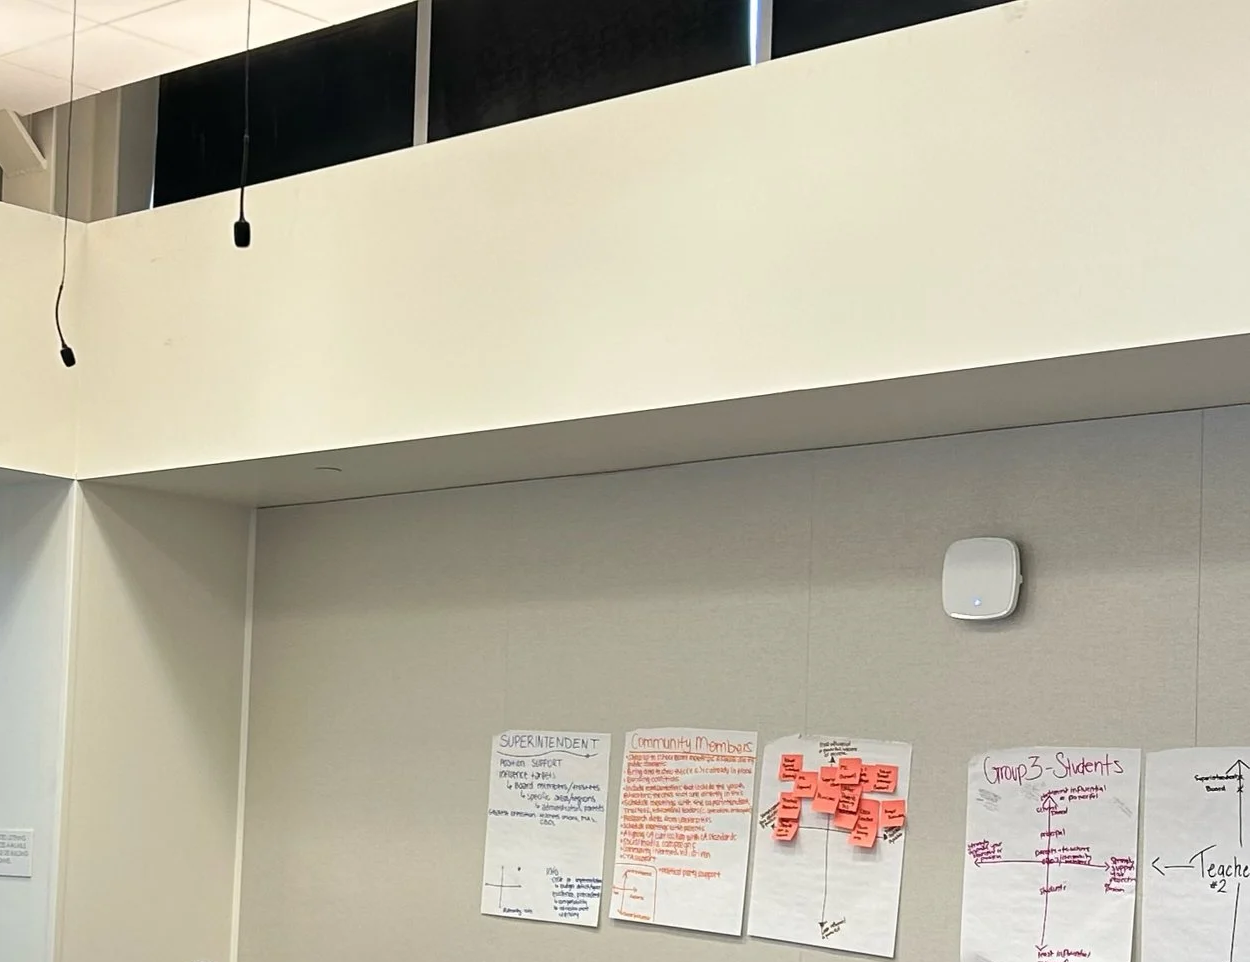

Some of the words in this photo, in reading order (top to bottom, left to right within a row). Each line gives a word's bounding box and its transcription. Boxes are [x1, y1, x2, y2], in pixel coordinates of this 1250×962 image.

[500, 734, 600, 749] SUPERINTENDENT
[632, 733, 691, 752] Community
[696, 736, 753, 753] Members
